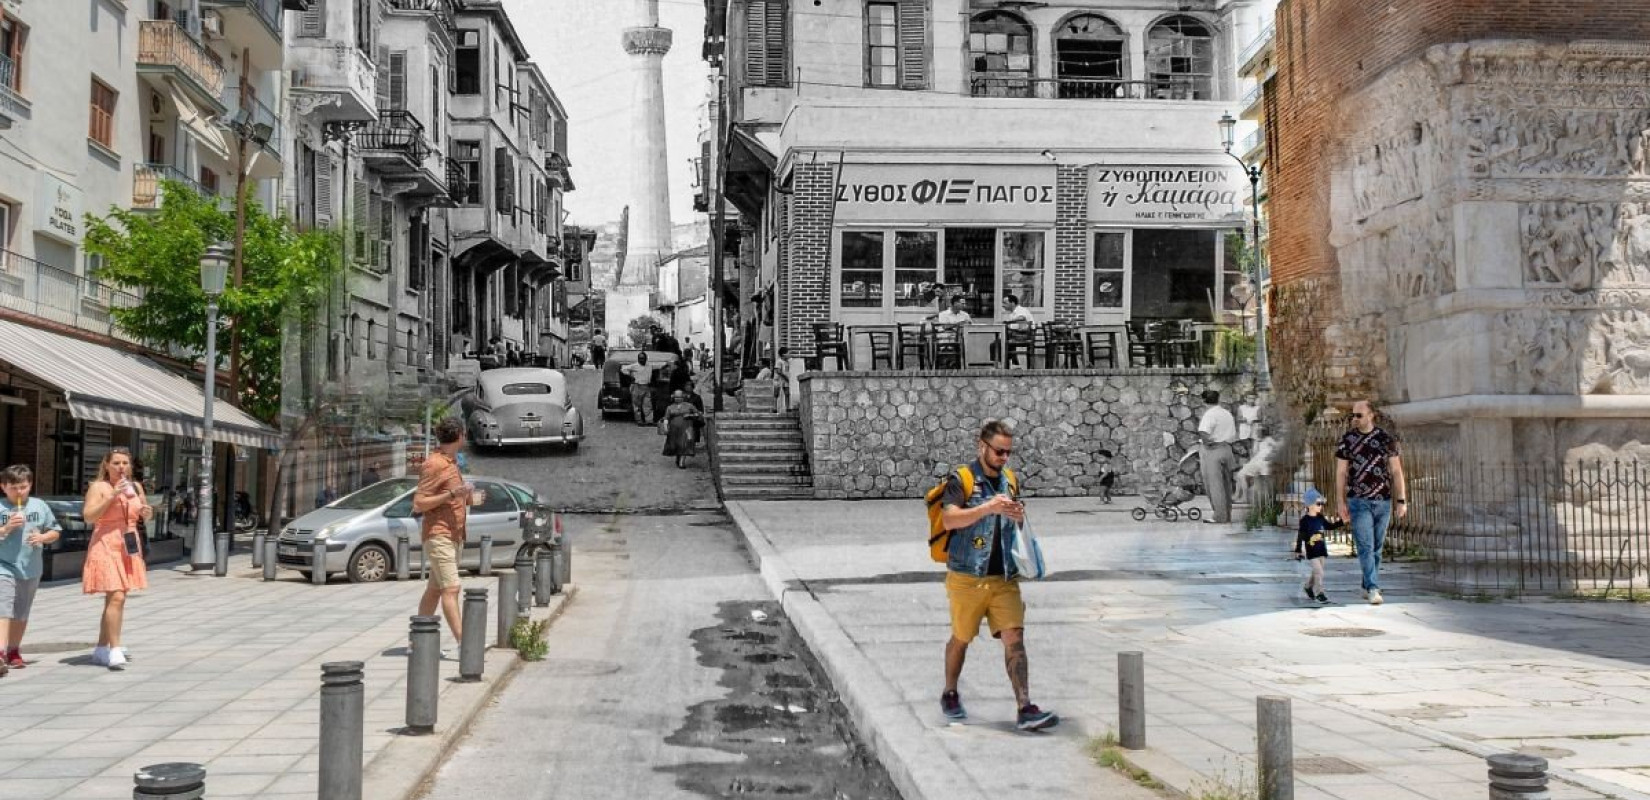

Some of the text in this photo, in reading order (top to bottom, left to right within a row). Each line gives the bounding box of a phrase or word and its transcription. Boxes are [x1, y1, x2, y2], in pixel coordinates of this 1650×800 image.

[1098, 170, 1228, 183] ΖΥΘΟΠΩΛΕΙΟΝ
[836, 179, 1053, 204] ΖΥΘΟΣ ΦΙΞ ΠΑΓΟΣ
[1126, 180, 1236, 211] Καμάρα
[54, 206, 72, 221] YOGA
[49, 216, 76, 235] PILATES
